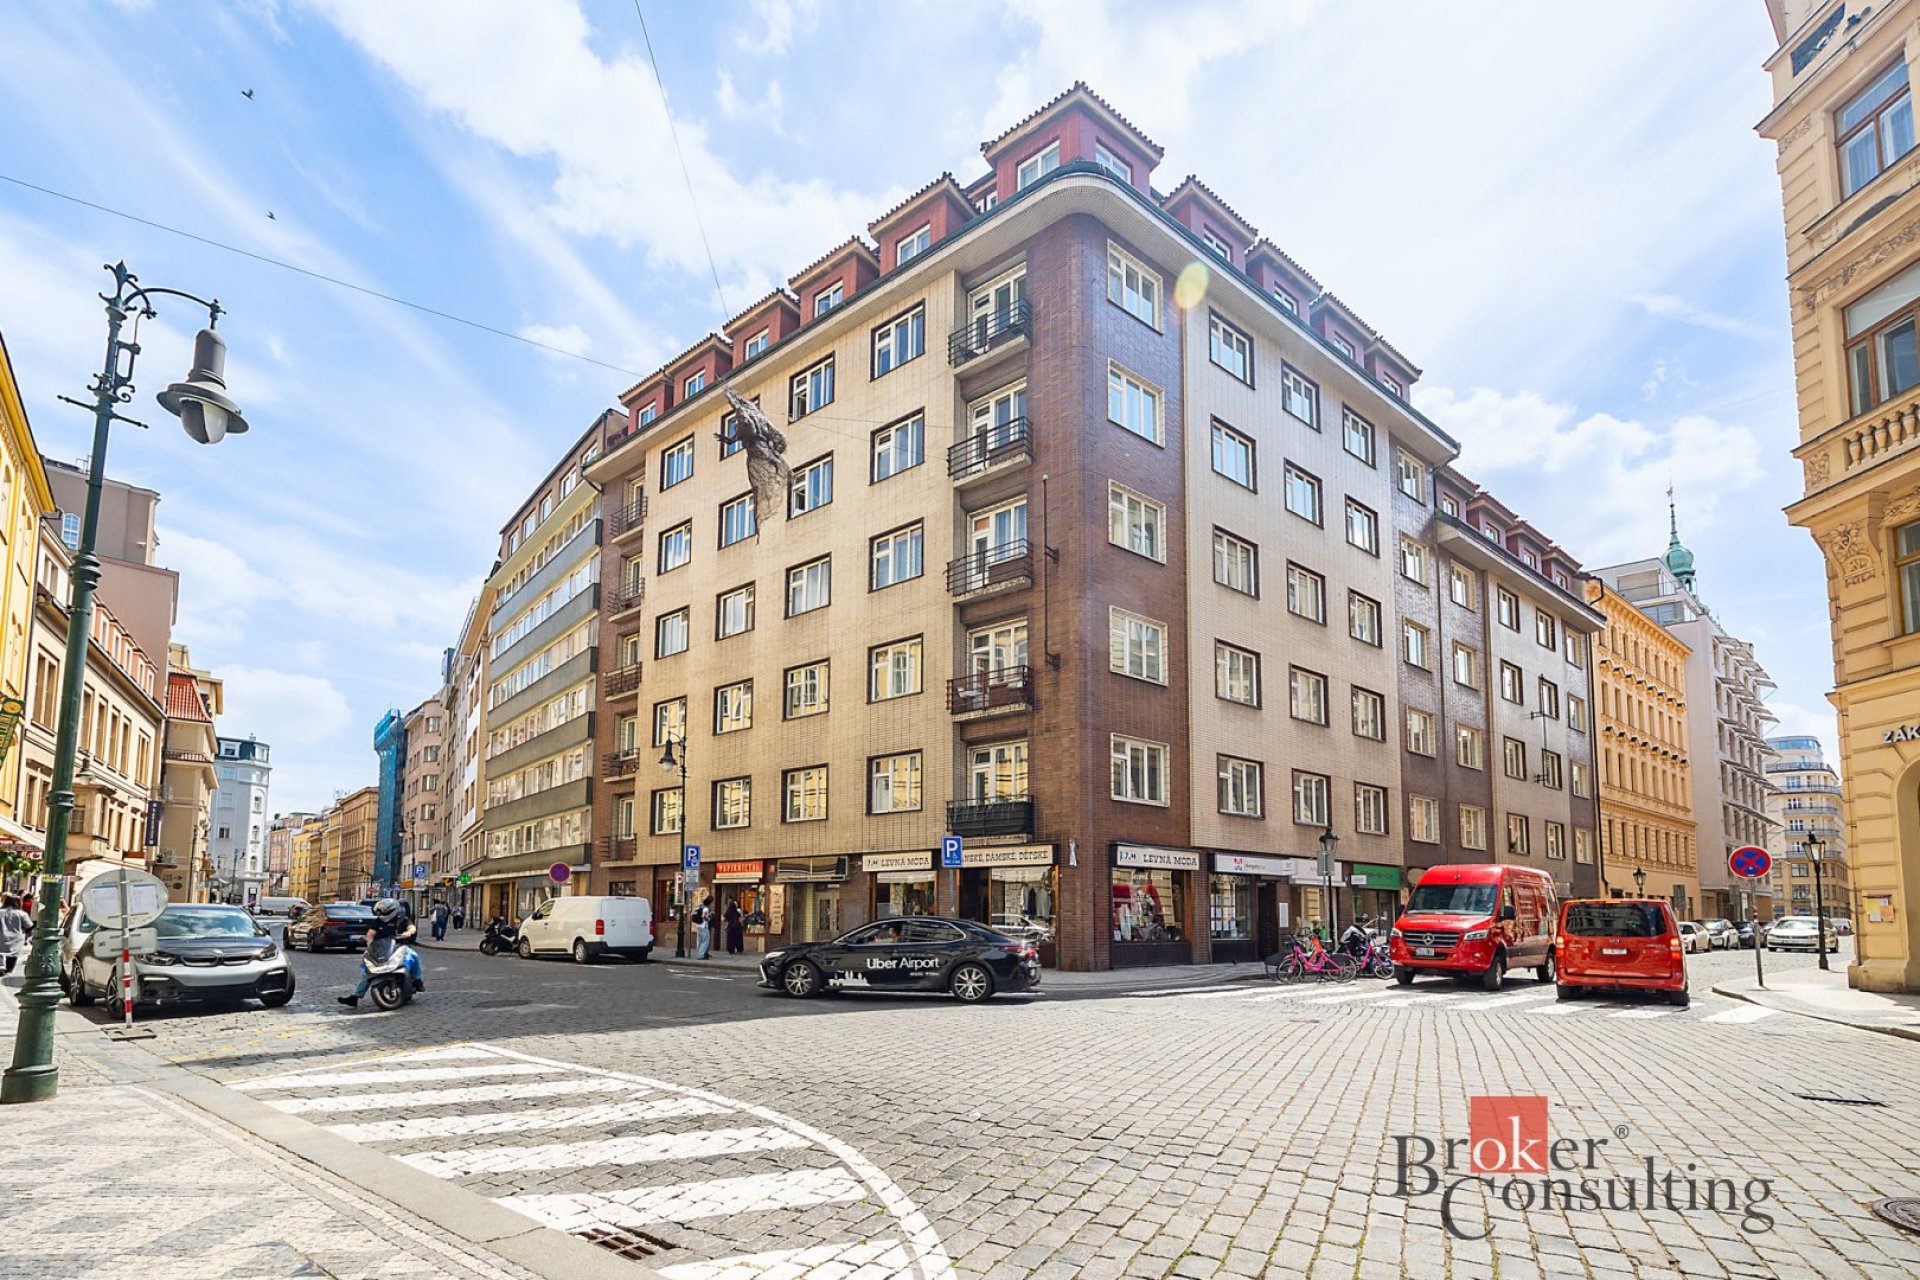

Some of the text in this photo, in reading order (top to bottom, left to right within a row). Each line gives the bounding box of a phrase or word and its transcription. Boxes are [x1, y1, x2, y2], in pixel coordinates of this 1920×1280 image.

[688, 848, 698, 860] P
[946, 840, 958, 858] P
[866, 957, 939, 971] Uber Airport
